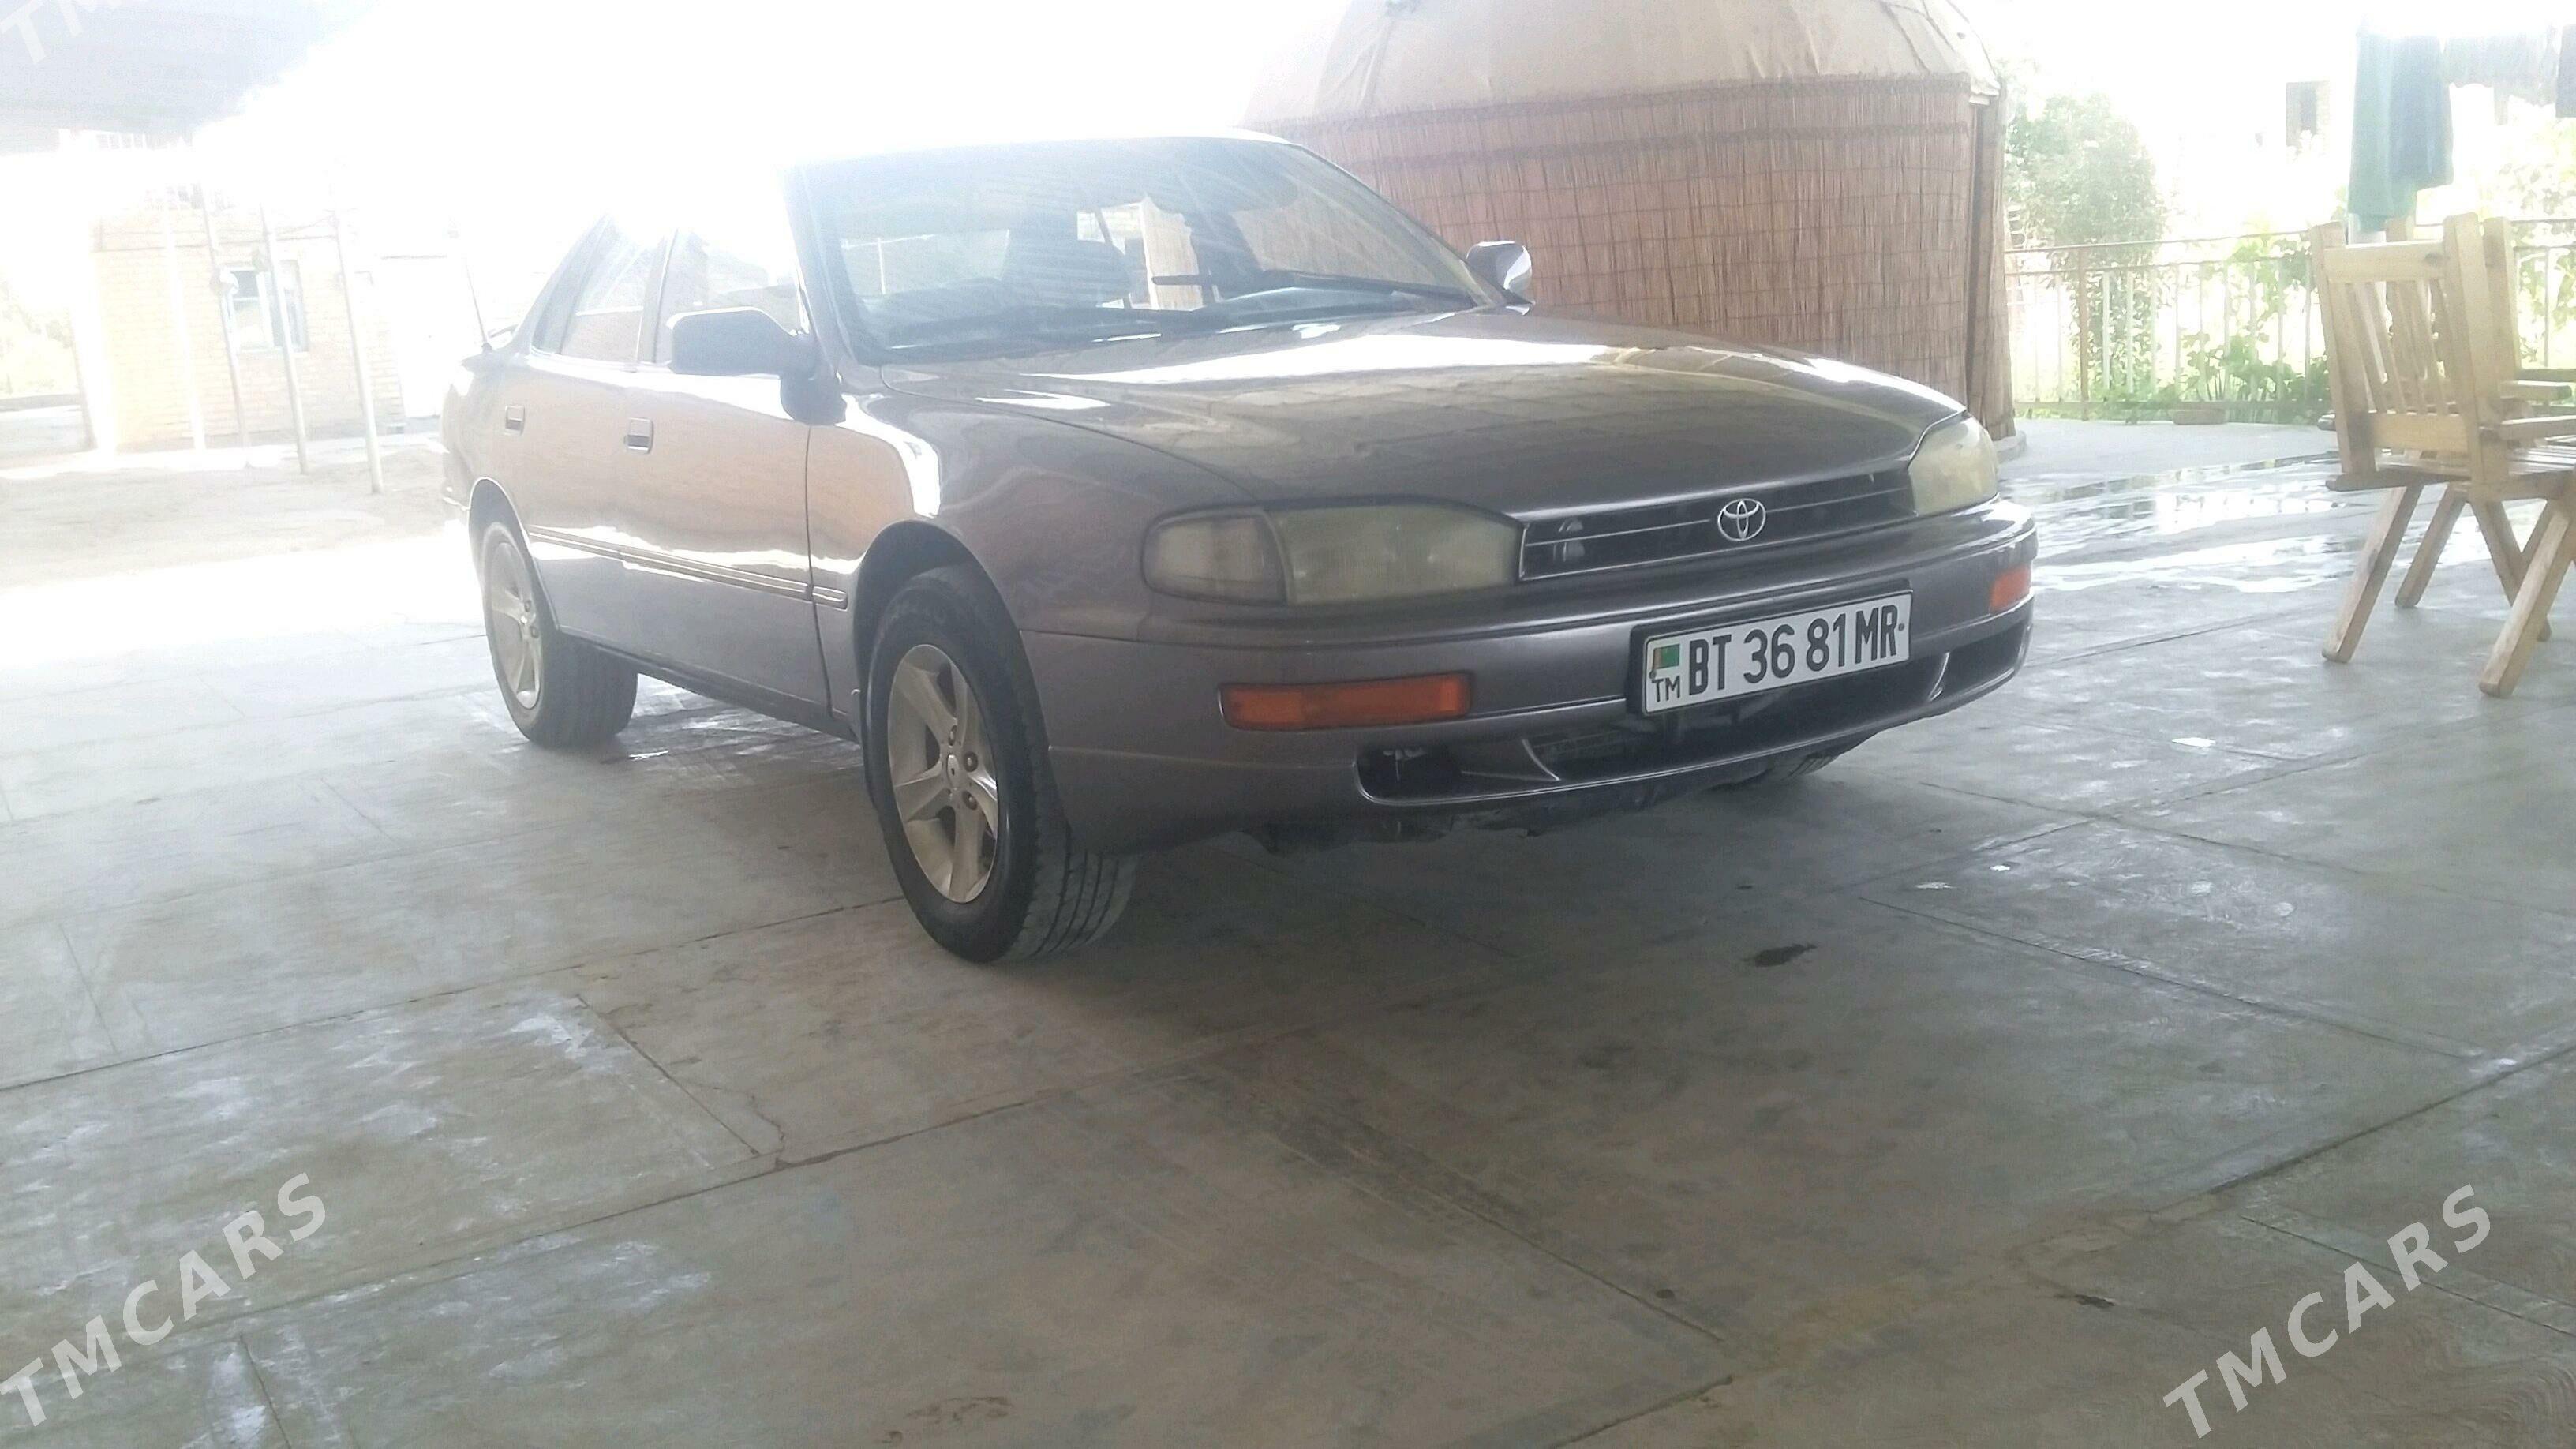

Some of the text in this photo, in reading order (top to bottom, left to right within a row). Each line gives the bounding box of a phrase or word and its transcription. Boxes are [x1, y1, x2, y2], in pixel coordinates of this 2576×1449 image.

[1689, 634, 1732, 696] BT
[1743, 624, 1796, 684] 36
[1855, 605, 1898, 665] MR
[1653, 674, 1681, 703] TM
